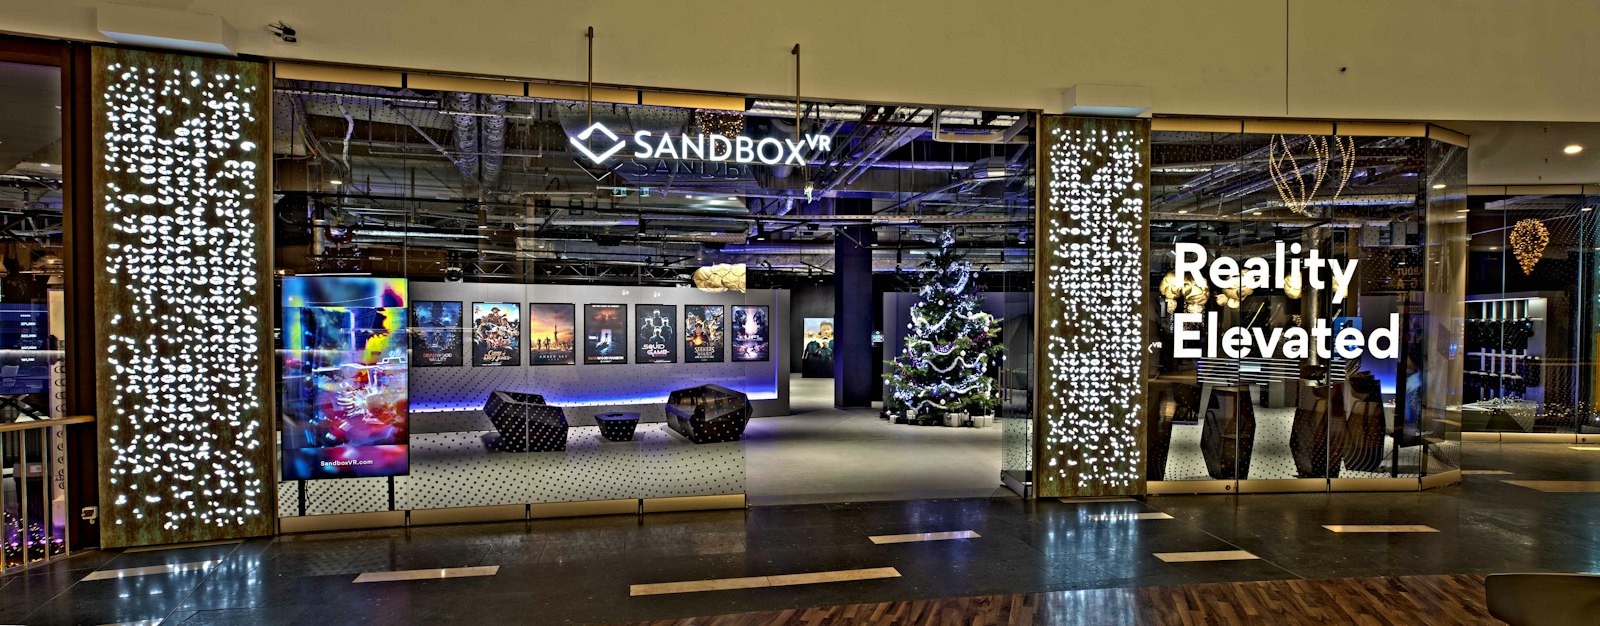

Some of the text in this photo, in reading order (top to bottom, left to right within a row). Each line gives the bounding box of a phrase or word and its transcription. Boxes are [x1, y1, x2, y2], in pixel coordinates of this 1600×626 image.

[634, 130, 806, 166] SANDBOX
[1175, 241, 1359, 304] Reality
[642, 342, 665, 350] SQUID
[1173, 312, 1400, 359] Elevated
